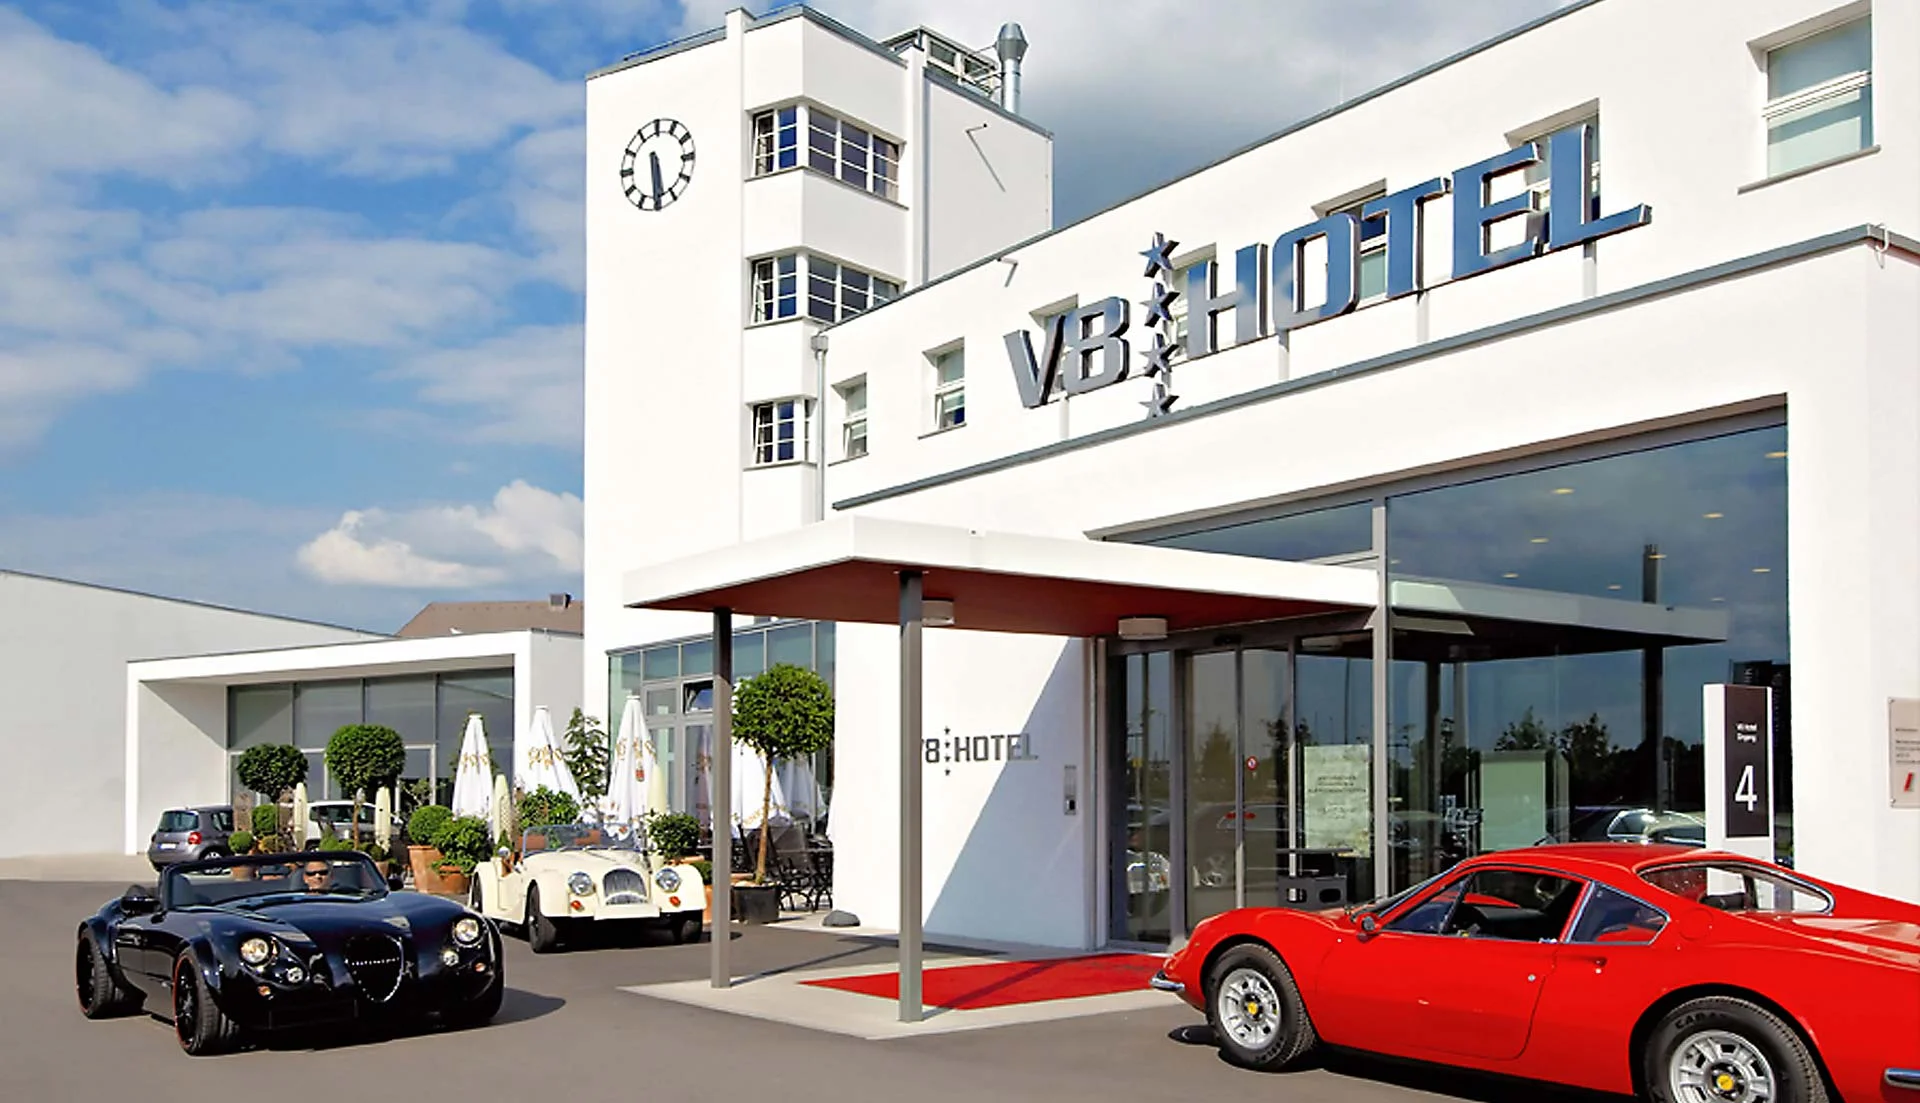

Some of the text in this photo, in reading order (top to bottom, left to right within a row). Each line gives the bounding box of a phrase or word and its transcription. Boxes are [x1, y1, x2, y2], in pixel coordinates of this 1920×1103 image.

[1003, 124, 1652, 409] V8 HOTEL
[921, 733, 1039, 763] 8 HOTEL
[1735, 765, 1758, 811] 4
